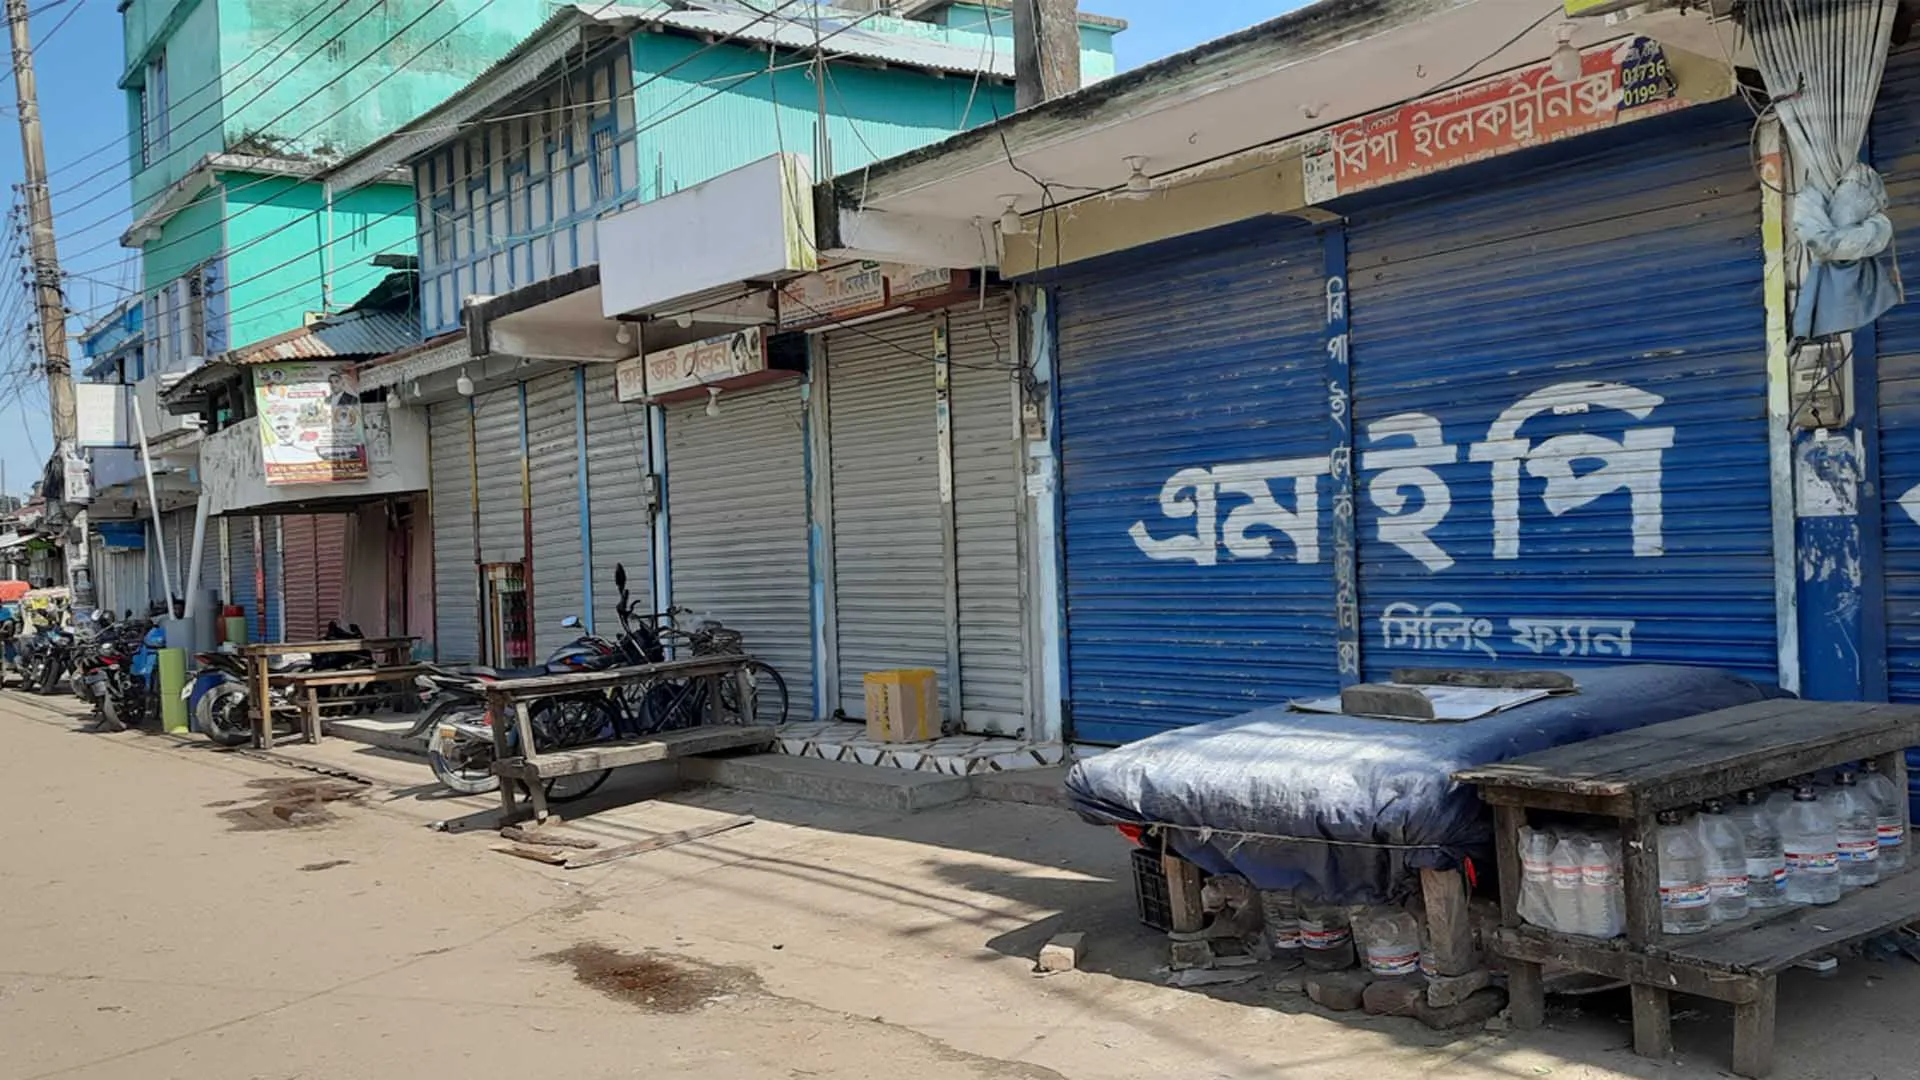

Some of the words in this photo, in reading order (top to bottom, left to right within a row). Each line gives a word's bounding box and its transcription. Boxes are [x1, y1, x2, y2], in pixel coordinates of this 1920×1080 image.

[1332, 118, 1399, 177] রিপা
[1380, 601, 1498, 662] সিলিং
[1508, 618, 1636, 657] ফ্যান
